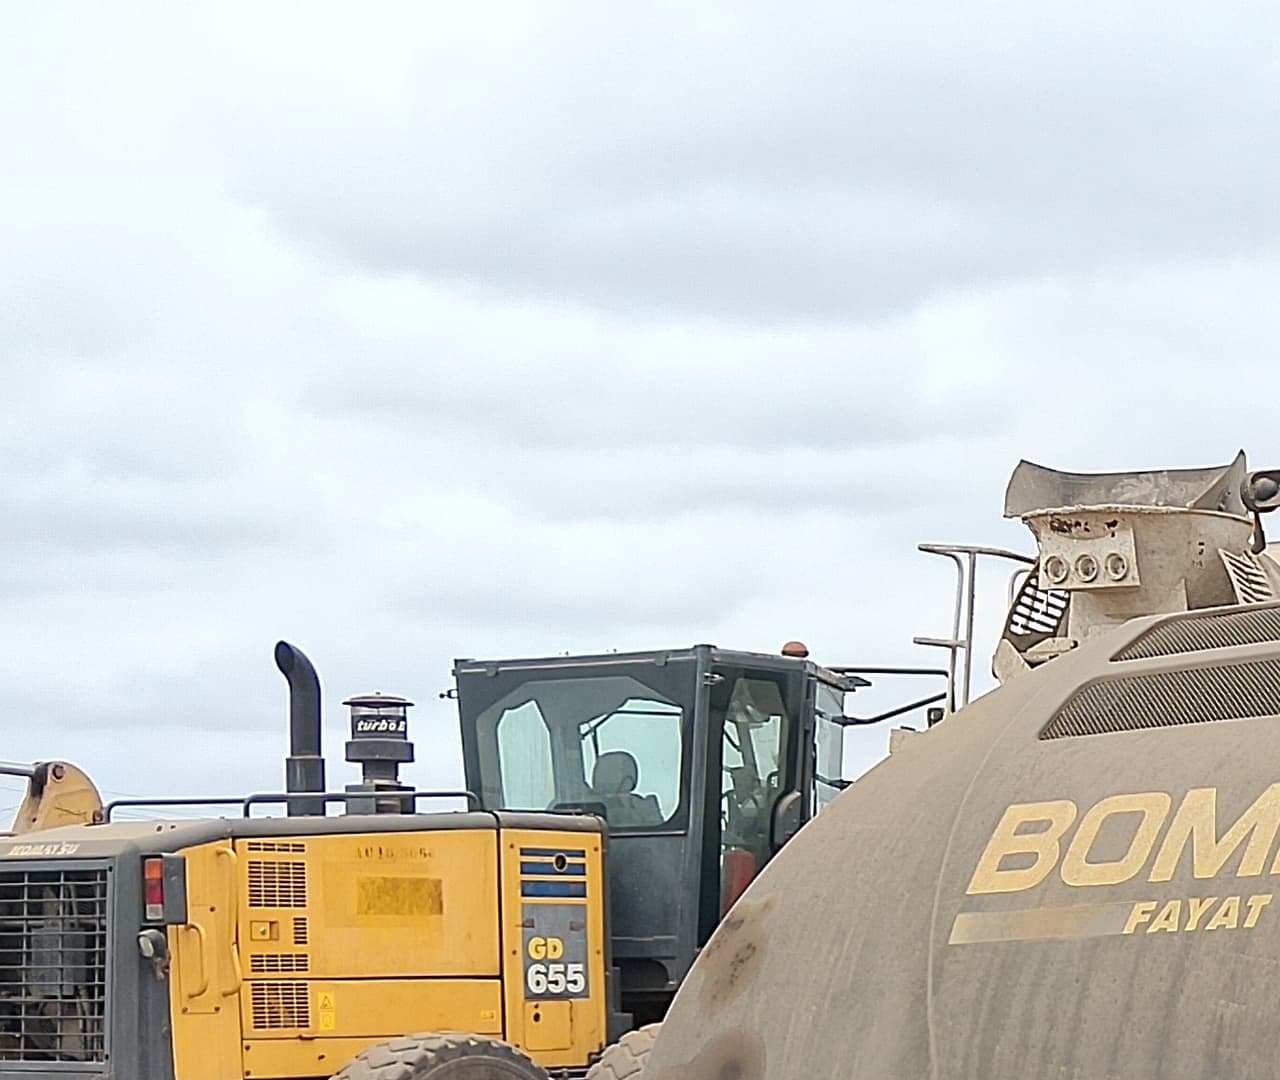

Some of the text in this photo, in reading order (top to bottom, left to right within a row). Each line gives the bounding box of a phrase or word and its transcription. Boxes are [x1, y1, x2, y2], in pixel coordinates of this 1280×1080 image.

[357, 719, 396, 732] turbo
[1122, 893, 1270, 935] FAYAT
[527, 936, 564, 961] GD
[526, 963, 586, 994] 655
